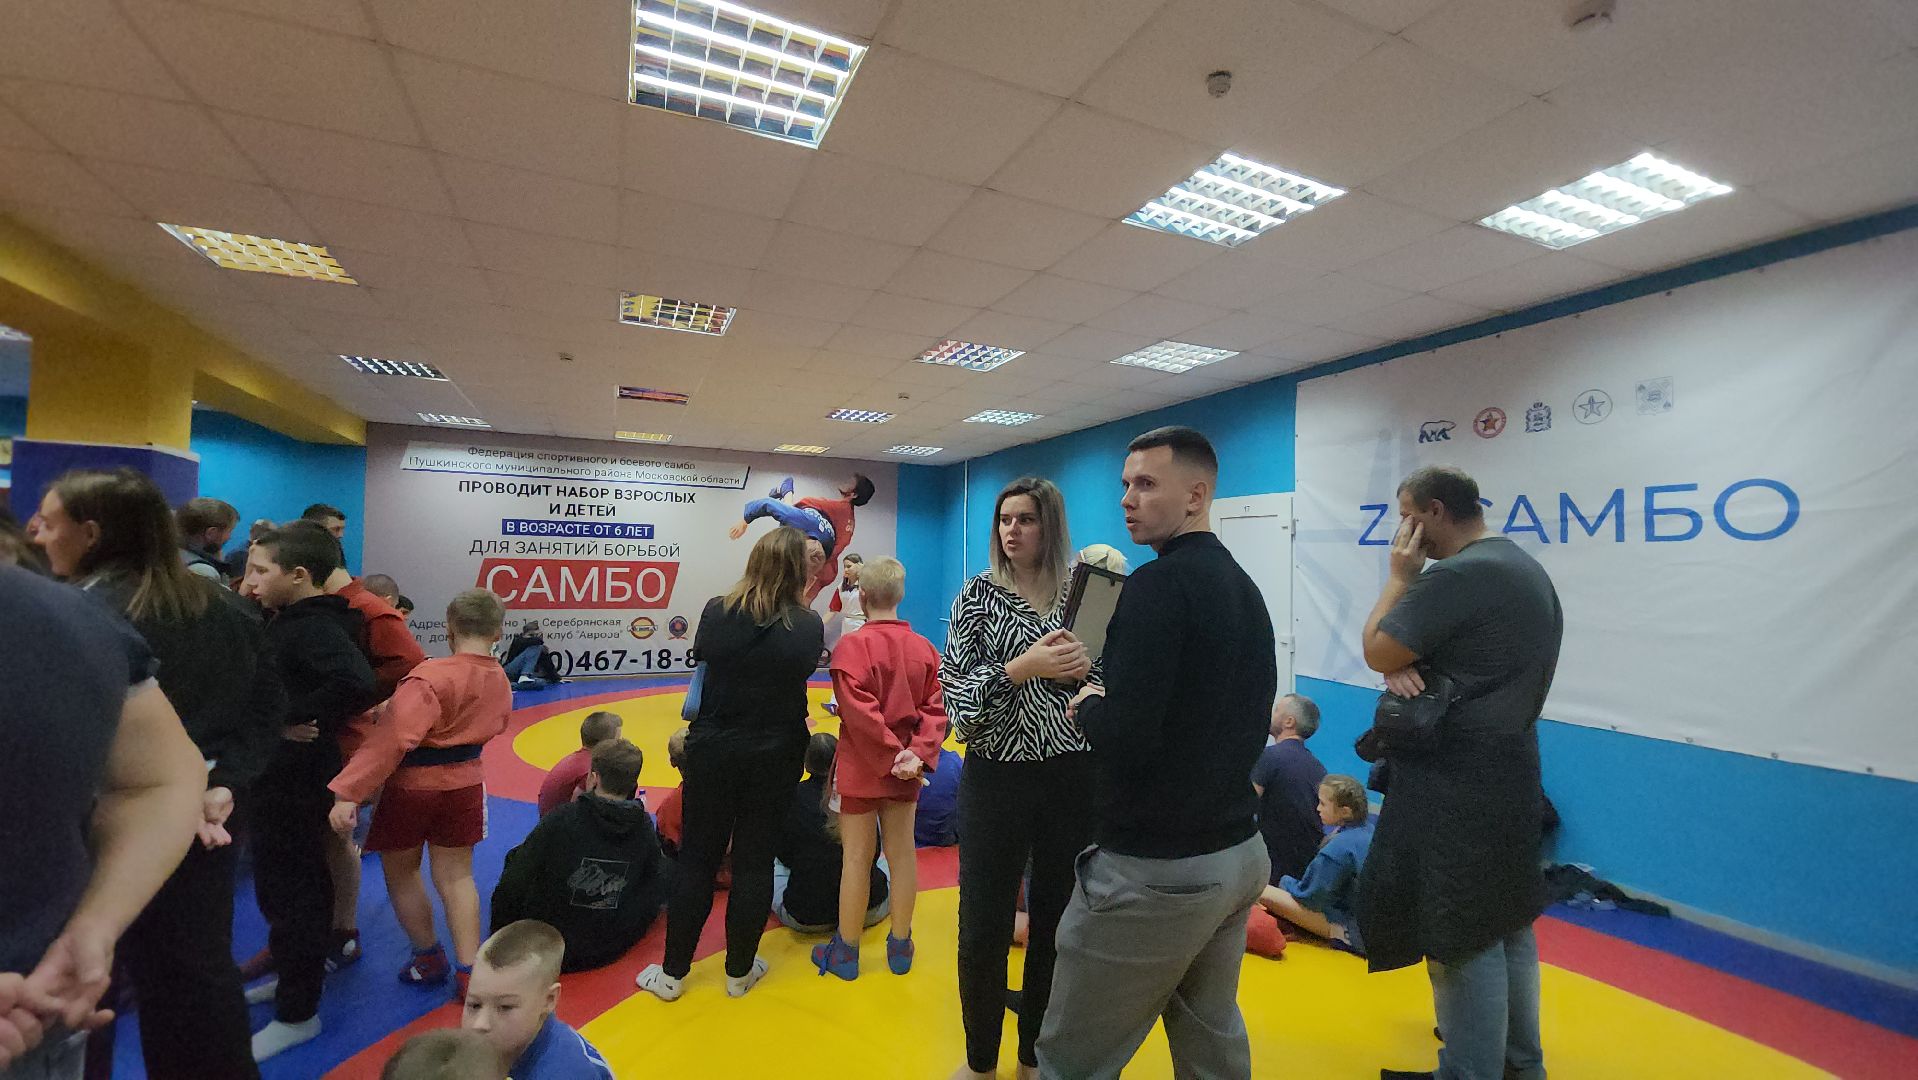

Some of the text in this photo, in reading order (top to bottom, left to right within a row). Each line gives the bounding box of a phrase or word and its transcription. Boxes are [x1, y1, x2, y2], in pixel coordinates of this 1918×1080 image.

[467, 446, 696, 469] Федерация спортивного и боевого самбо
[409, 455, 740, 485] Пушкинского муниципального района Московской области
[458, 480, 696, 504] ПРОВОДИТ НАБОР ВЗРОСЛЫХ
[549, 503, 616, 518] И ДЕТЕЙ
[1478, 478, 1800, 545] АМБО
[506, 522, 651, 537] В ВОЗРАСТЕ ОТ 6 ЛЕТ
[469, 540, 681, 558] ДЛЯ ЗАНЯТИЙ БОРЬБОЙ
[486, 565, 666, 603] САМБО
[542, 617, 622, 629] Серебрянская
[547, 630, 573, 642] клуб
